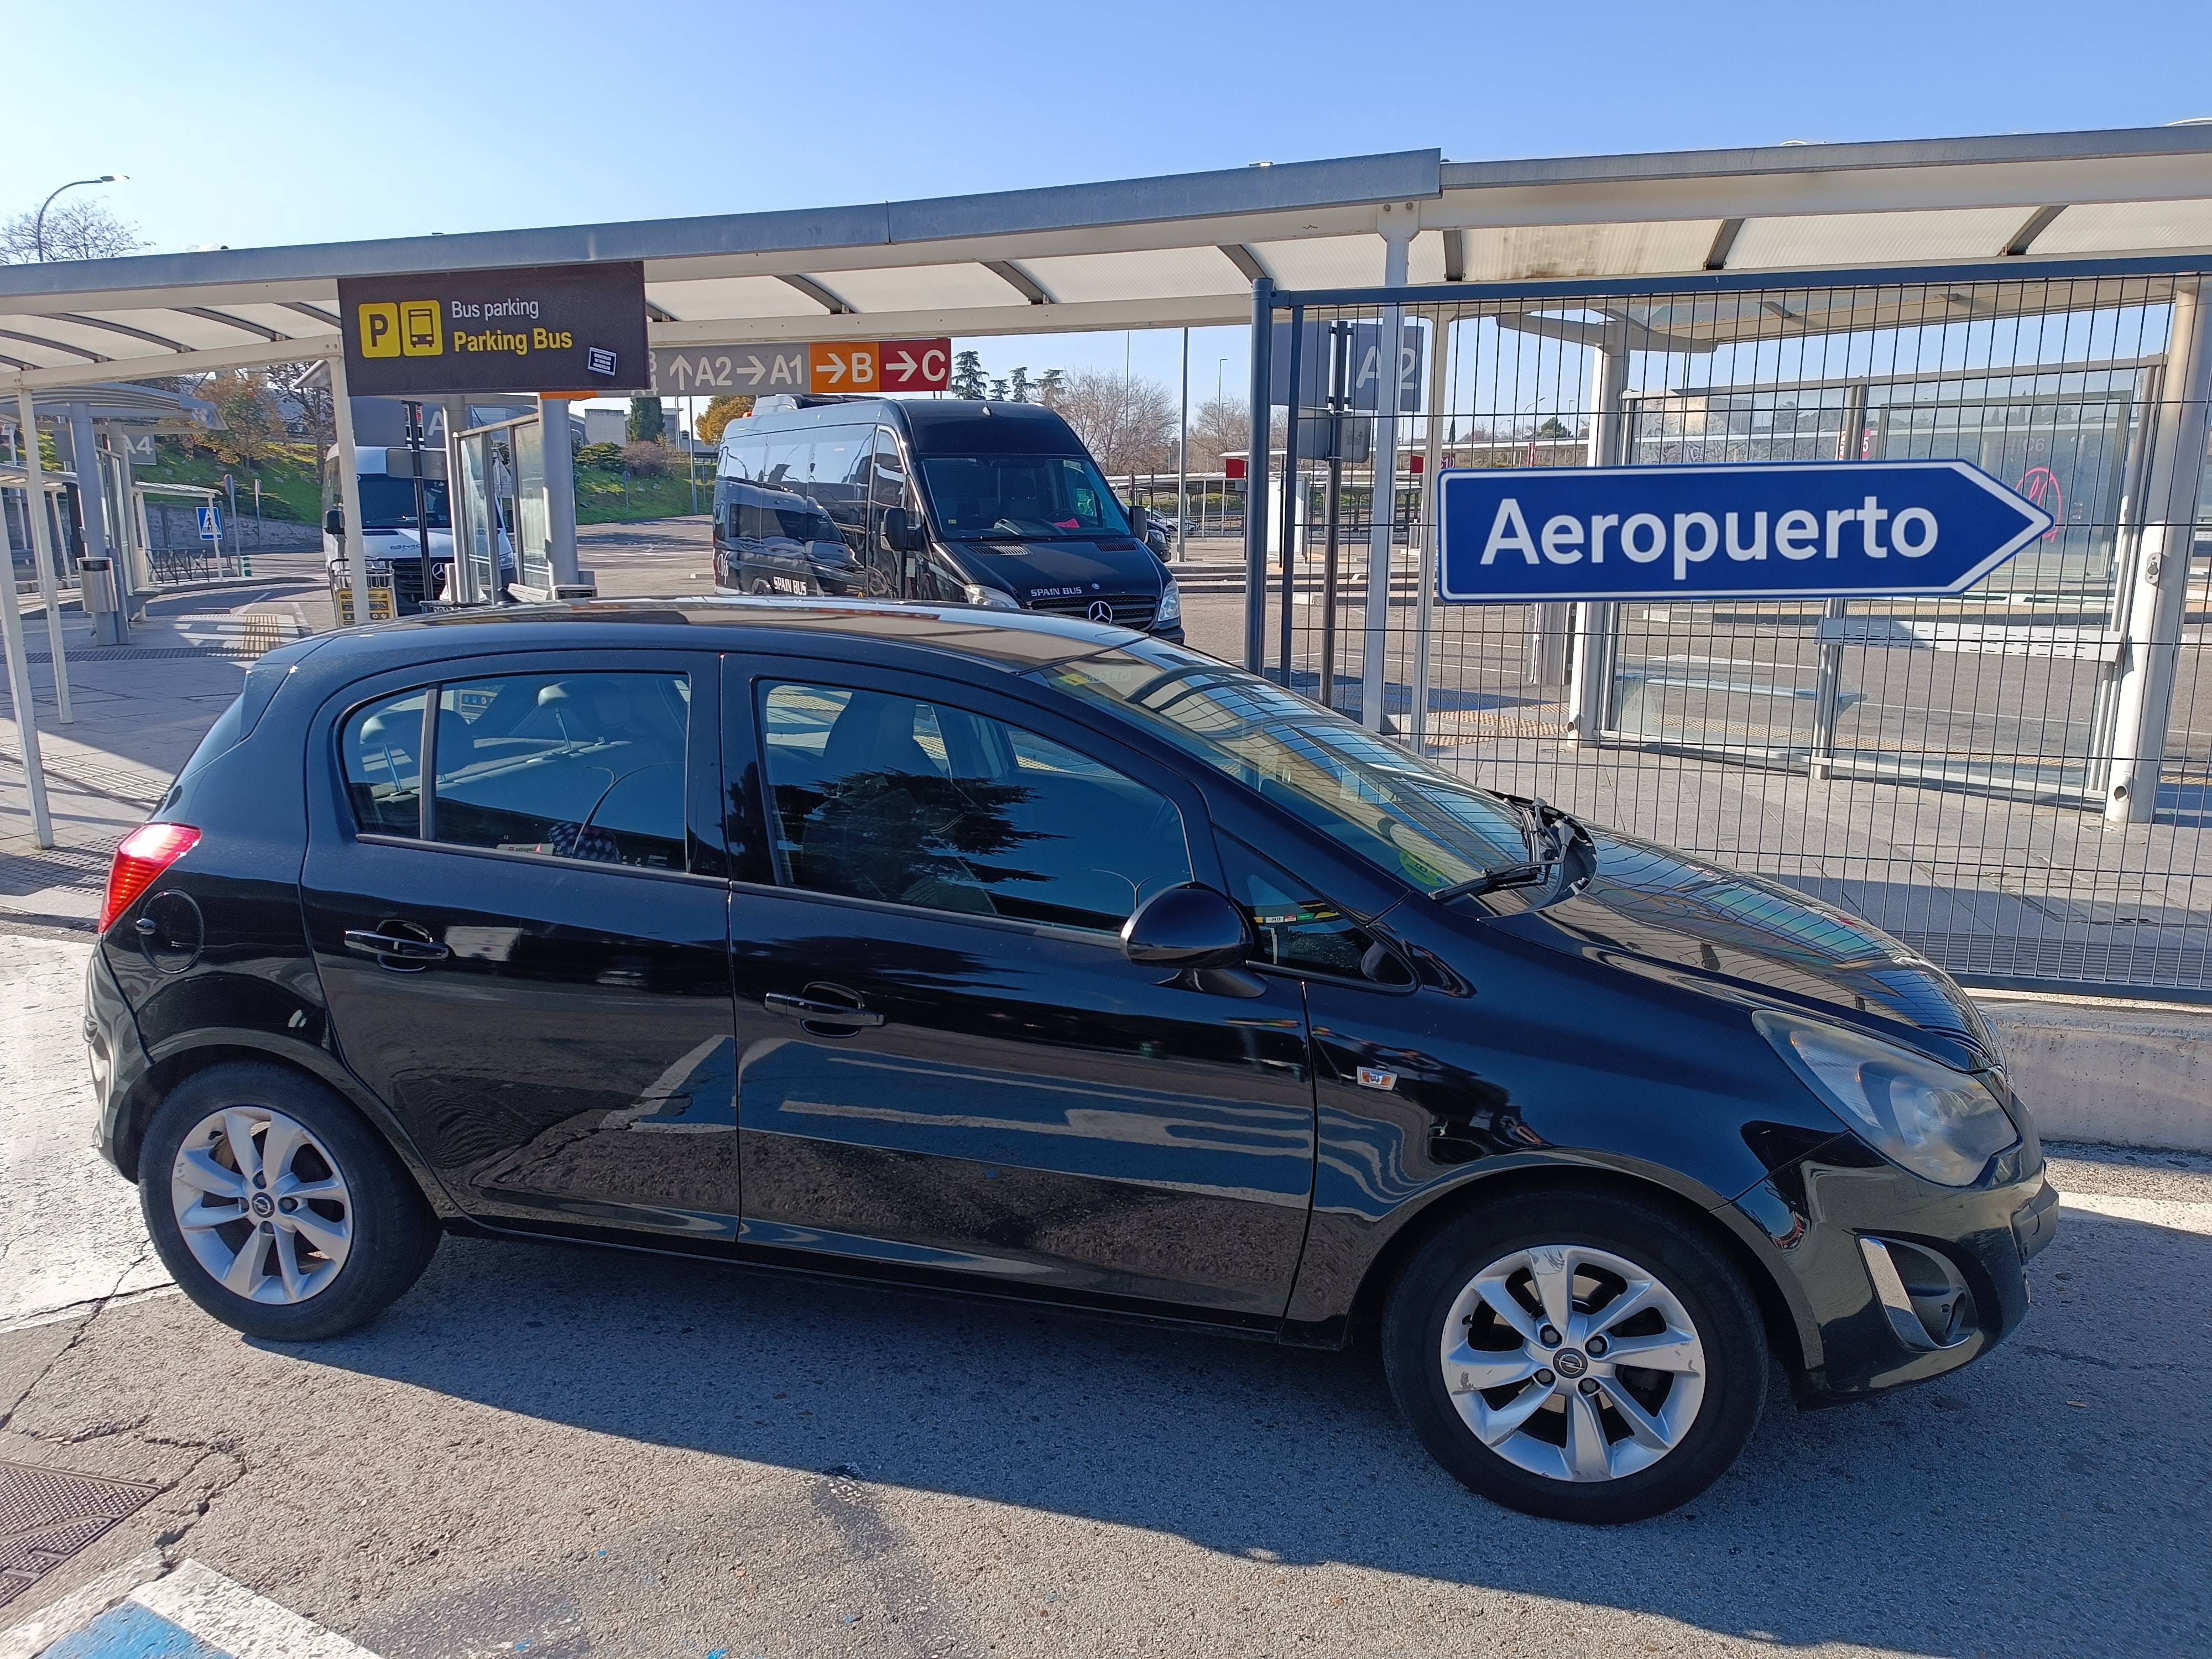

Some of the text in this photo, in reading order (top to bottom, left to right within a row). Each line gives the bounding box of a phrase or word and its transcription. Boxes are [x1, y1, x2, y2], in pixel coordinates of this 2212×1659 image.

[451, 298, 540, 321] Bus parking
[369, 314, 388, 347] P
[453, 327, 573, 355] Parking Bus
[695, 349, 946, 387] A2 A1 B C
[1480, 496, 1938, 581] Aeropuerto
[773, 576, 807, 596] SPAIN BUS
[1030, 588, 1060, 597] SPAIN
